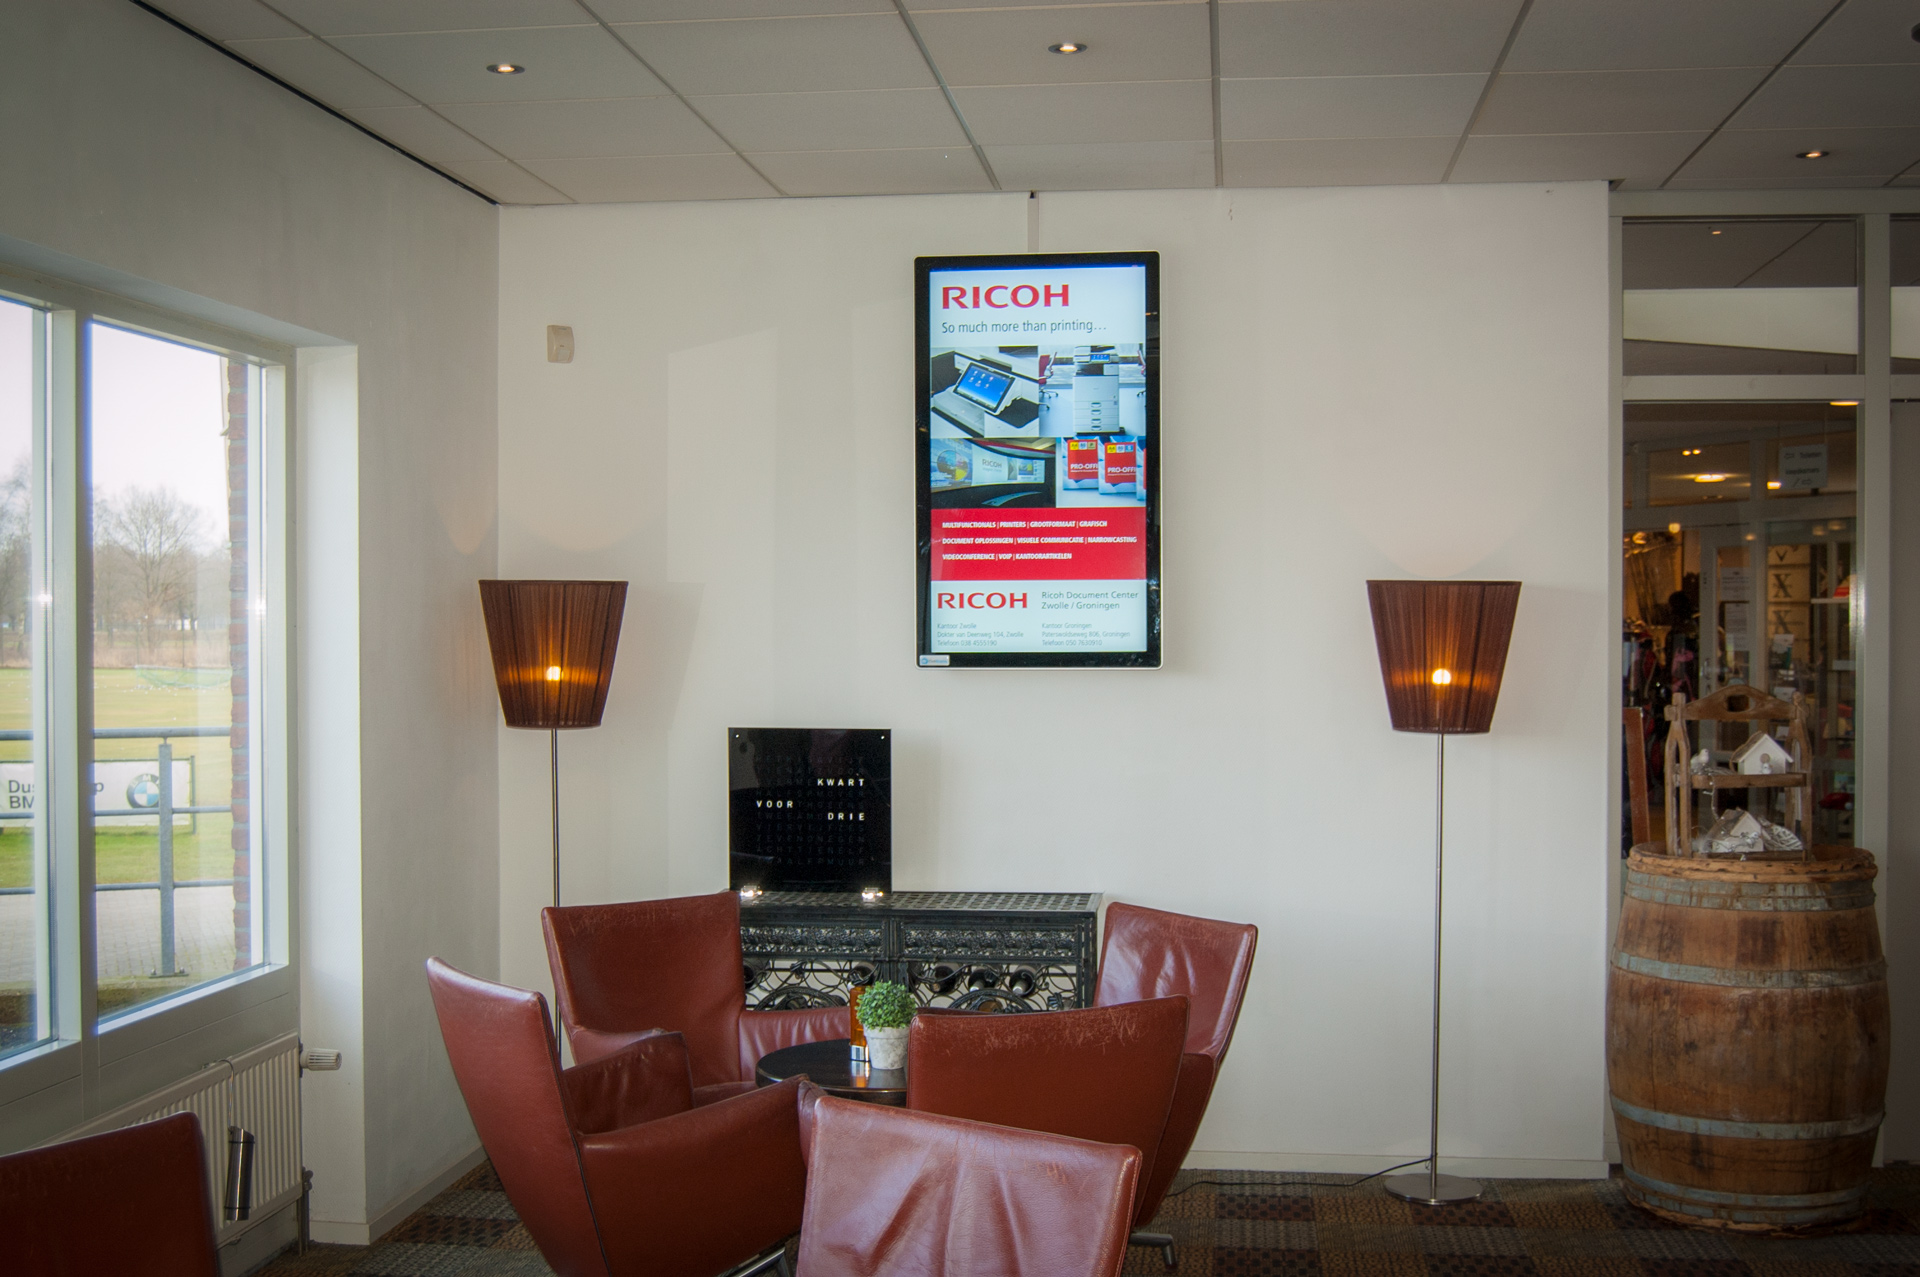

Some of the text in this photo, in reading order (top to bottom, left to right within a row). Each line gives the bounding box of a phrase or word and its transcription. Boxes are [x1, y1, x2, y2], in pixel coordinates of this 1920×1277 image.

[942, 284, 1069, 309] RICOH
[942, 322, 955, 333] So
[958, 321, 988, 333] much
[991, 323, 1019, 332] more
[1023, 320, 1047, 332] than
[1041, 591, 1139, 599] Ricoh Document Center
[937, 592, 1027, 609] RICOH
[1076, 602, 1120, 610] Groningen
[817, 778, 865, 786] KWART
[9, 795, 35, 809] BM
[756, 800, 793, 808] VOOR
[828, 812, 865, 820] DRIE
